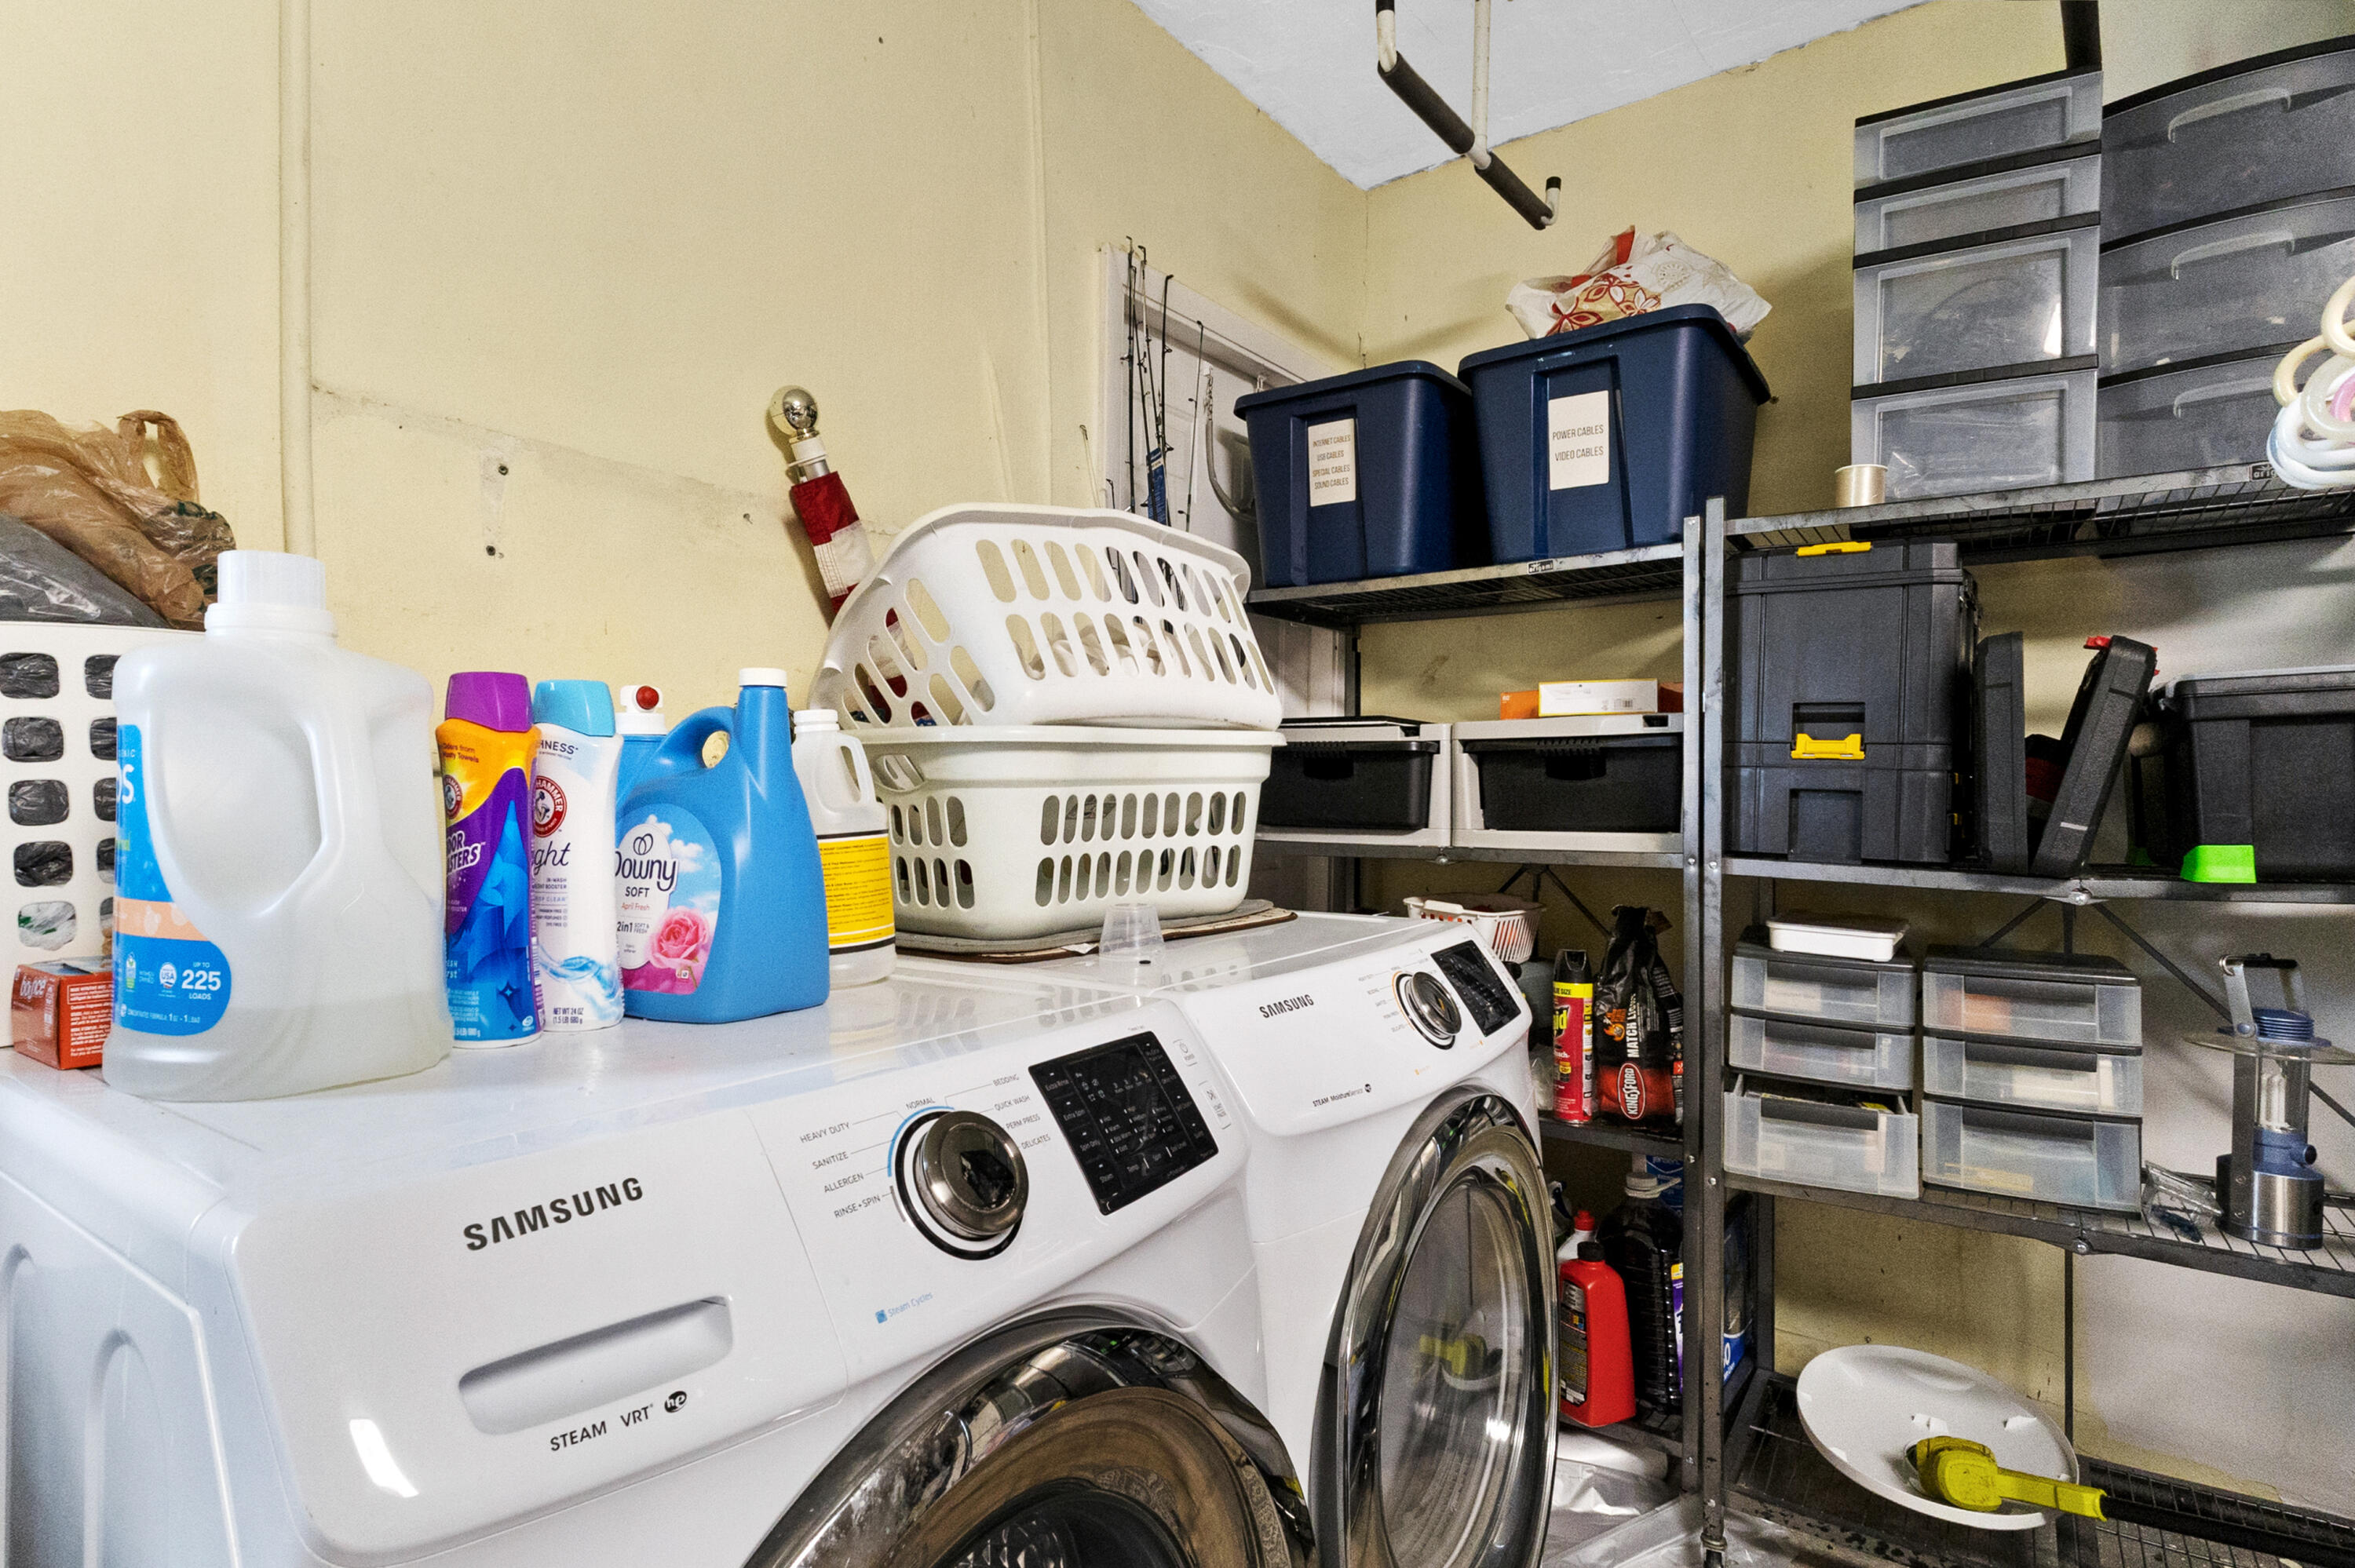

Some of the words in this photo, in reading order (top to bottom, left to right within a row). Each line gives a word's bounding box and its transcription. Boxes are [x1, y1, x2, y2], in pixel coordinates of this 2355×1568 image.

[1552, 428, 1575, 440] POWER
[1577, 424, 1604, 437] CABLES
[1313, 436, 1333, 447] INTERNET
[1334, 434, 1351, 444] CABLES
[1327, 450, 1344, 460] CABLES
[1555, 450, 1575, 461] VIDEO
[1576, 445, 1604, 458] CABLES
[1313, 467, 1331, 477] SPECIAL
[1331, 465, 1350, 474] CABLES
[1314, 480, 1330, 490] SOUND
[1331, 477, 1349, 487] CABLES
[615, 851, 677, 892] Downy
[625, 886, 650, 898] SOFT
[621, 902, 634, 910] April
[634, 903, 650, 911] Fresh
[616, 921, 633, 932] 2in1
[181, 969, 221, 991] 225
[1259, 994, 1315, 1019] SAMSUNG
[1626, 1022, 1640, 1058] MATCH
[993, 1074, 1020, 1086] BEDDING
[1623, 1067, 1641, 1115] KINGSFORD
[905, 1097, 936, 1110] NORMAL
[995, 1100, 1012, 1111] QUICK
[1013, 1095, 1031, 1106] WASH
[1313, 1096, 1329, 1107] STEAM
[1006, 1119, 1021, 1130] PERM
[1022, 1114, 1041, 1125] PRESS
[800, 1129, 827, 1143] HEAVY
[828, 1121, 849, 1135] DUTY
[1021, 1133, 1051, 1149] DELICATES
[812, 1151, 849, 1169] SANITIZE
[823, 1172, 864, 1193] ALLERGEN
[463, 1177, 644, 1251] SAMSUNG
[888, 1302, 911, 1317] Steam
[911, 1292, 933, 1306] Cycles
[550, 1420, 607, 1451] STEAM
